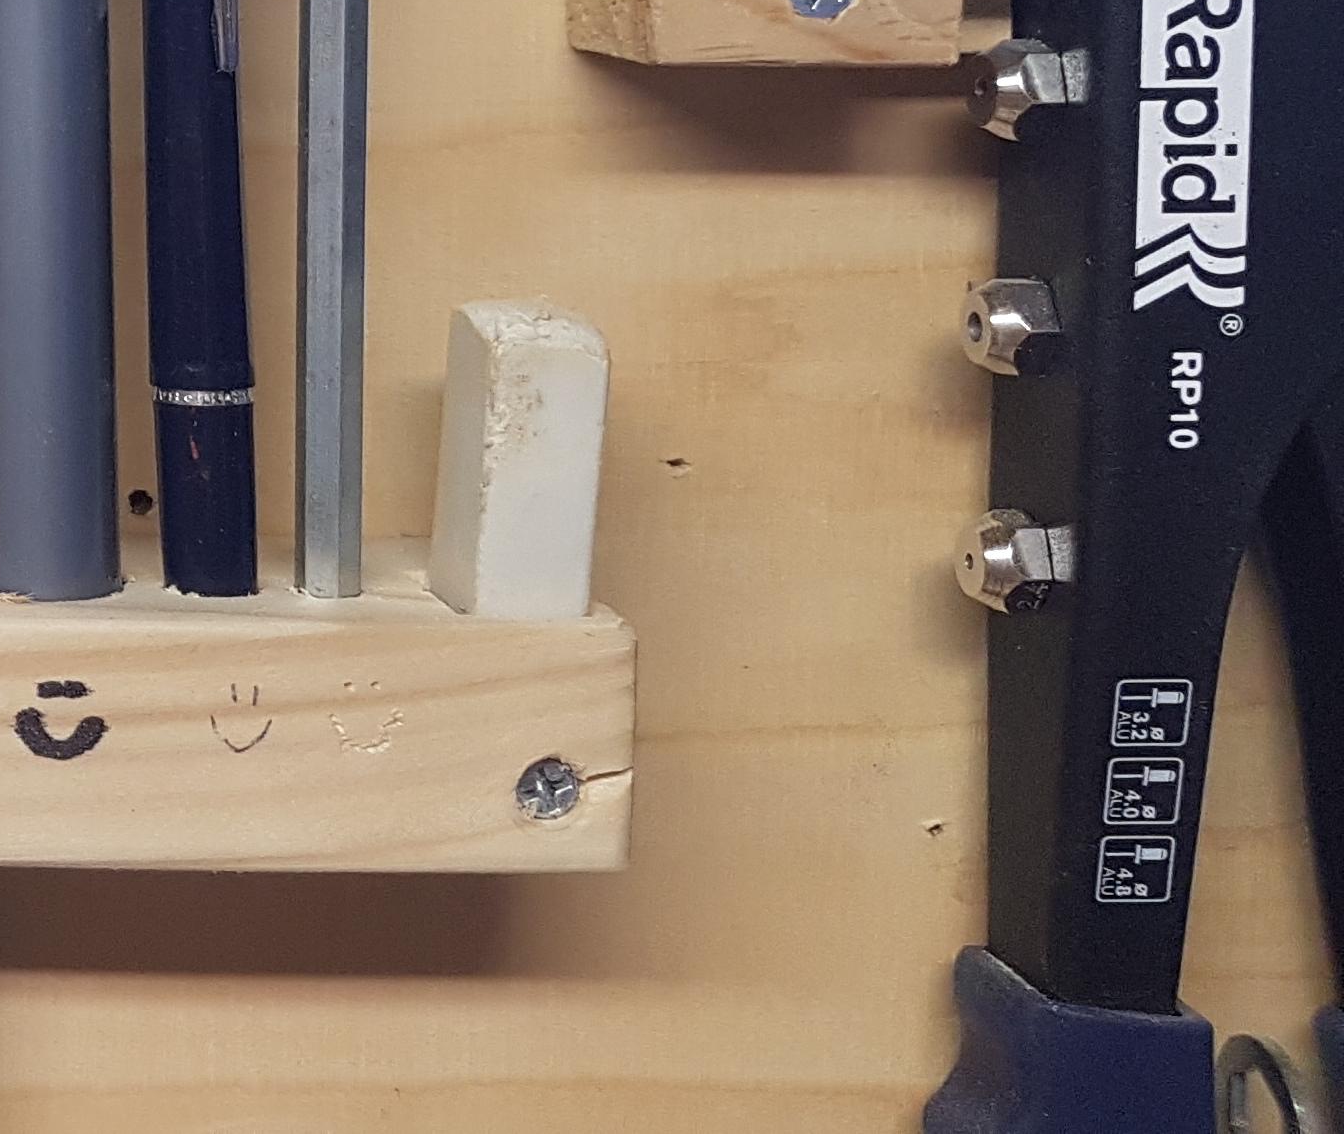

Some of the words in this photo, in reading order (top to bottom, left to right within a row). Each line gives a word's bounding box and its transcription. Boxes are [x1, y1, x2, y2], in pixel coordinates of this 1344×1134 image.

[1168, 351, 1203, 450] RP10
[1116, 711, 1131, 740] ALU
[1109, 789, 1124, 818] ALU
[1101, 867, 1116, 896] ALU
